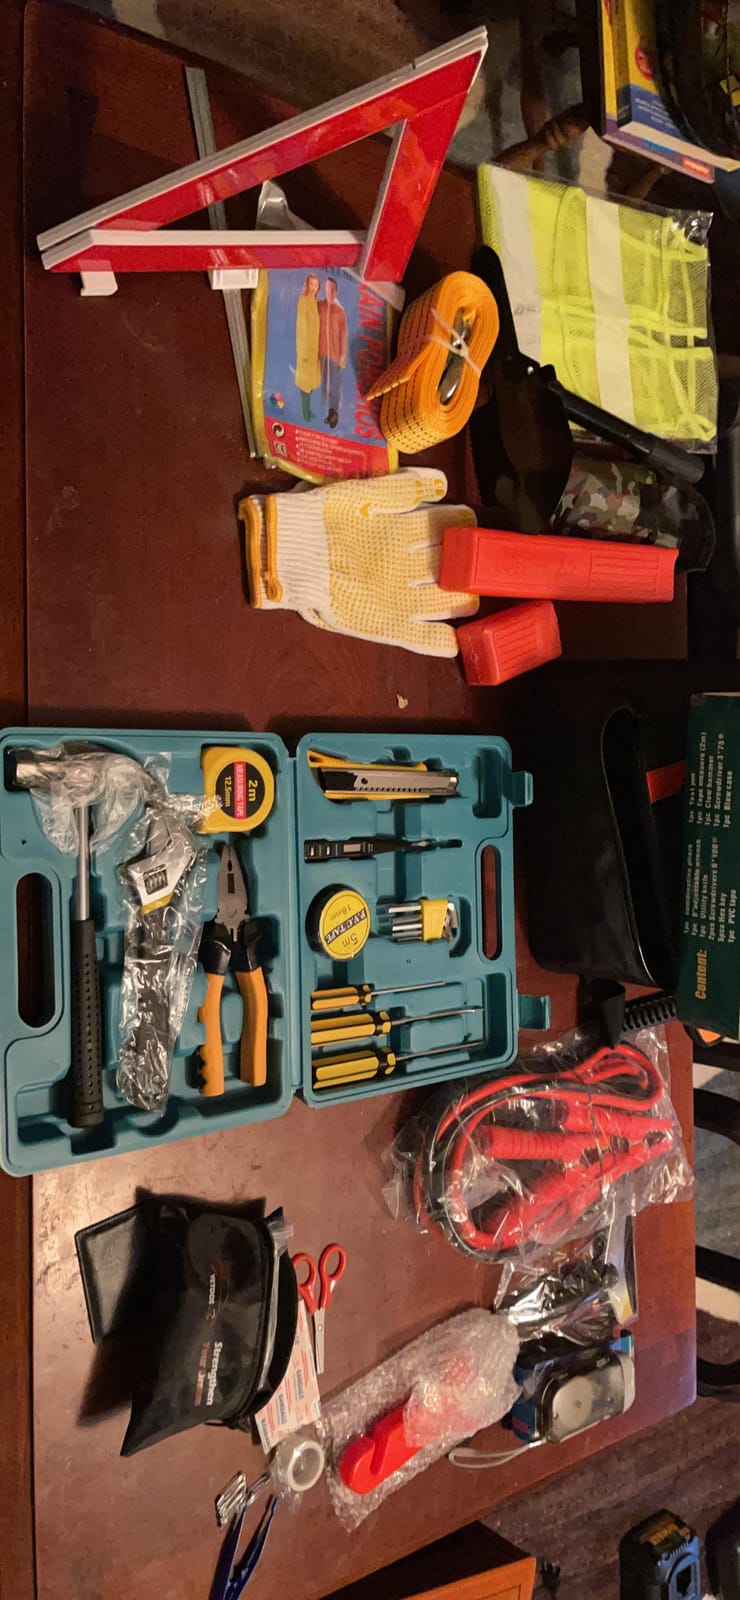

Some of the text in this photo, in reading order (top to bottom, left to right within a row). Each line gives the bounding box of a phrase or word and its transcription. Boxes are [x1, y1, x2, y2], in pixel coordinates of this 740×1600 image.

[715, 762, 723, 809] Screwdriver
[725, 771, 733, 789] case
[249, 780, 257, 801] 2m
[710, 870, 718, 921] Screwdrivers
[719, 892, 727, 906] key
[728, 889, 737, 907] tape
[700, 895, 708, 919] Utility
[728, 908, 736, 924] PVC
[342, 933, 358, 947] 5m
[708, 922, 716, 940] 2pcs
[695, 950, 707, 1000] Content:
[206, 1341, 223, 1406] Strengthen
